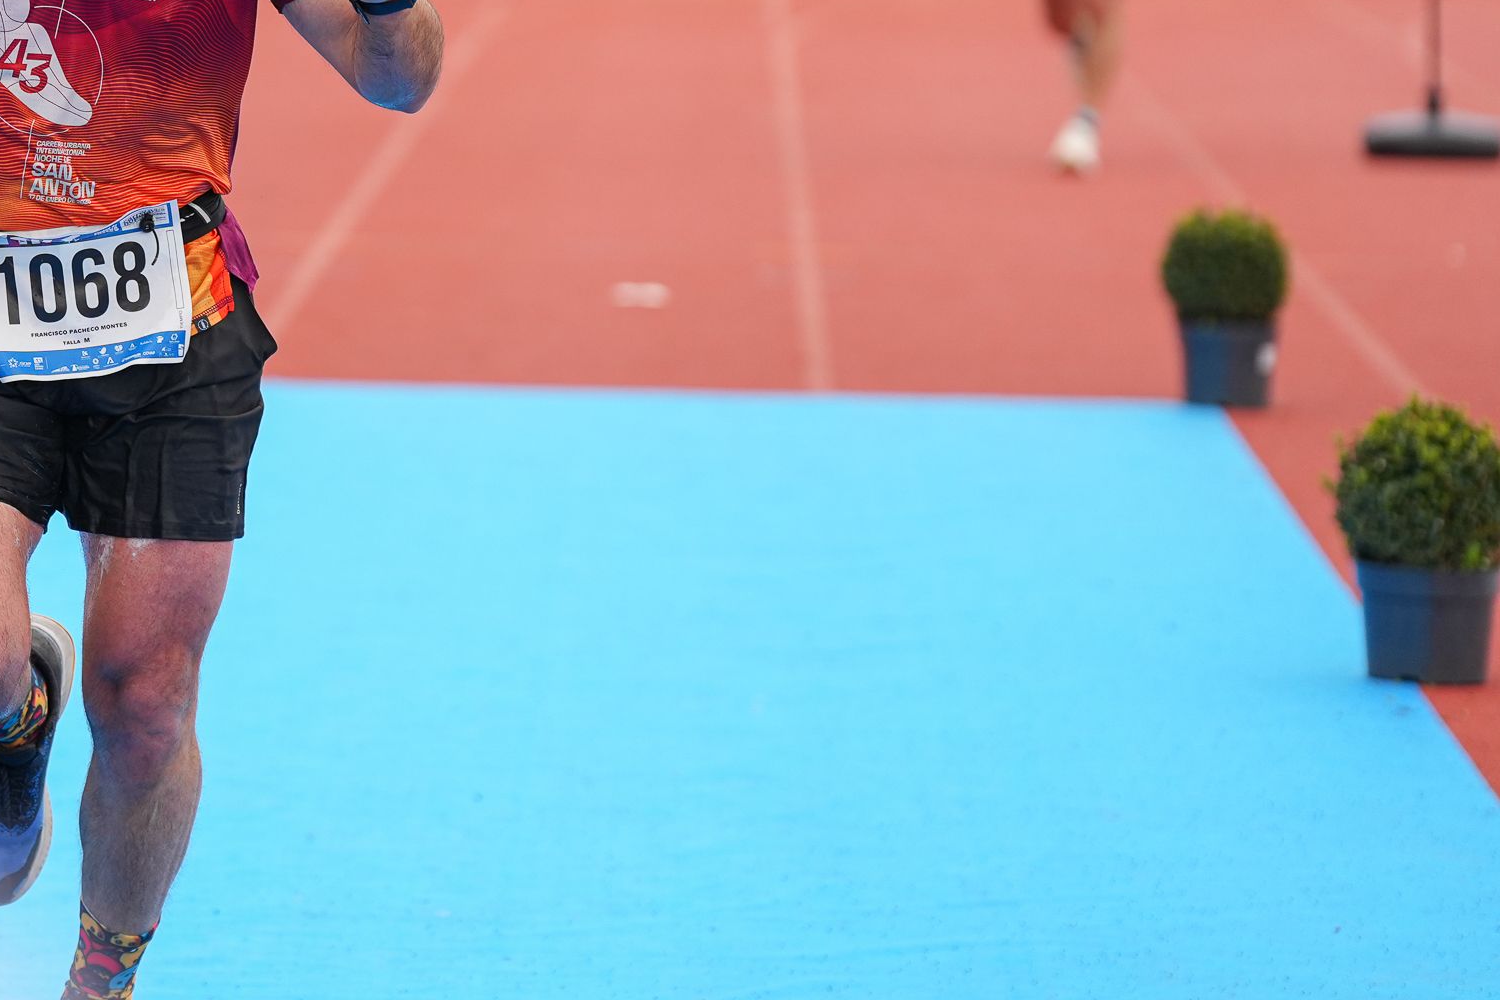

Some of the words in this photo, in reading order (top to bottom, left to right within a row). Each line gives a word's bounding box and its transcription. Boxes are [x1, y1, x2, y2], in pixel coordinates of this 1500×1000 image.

[33, 154, 63, 163] NOCHE
[63, 156, 72, 164] DE
[31, 162, 73, 181] SAN
[29, 176, 96, 199] ANTÓN
[36, 194, 45, 202] DE
[45, 195, 67, 203] ENERO
[31, 329, 68, 338] FRANCISCO
[69, 325, 99, 334] PACHECO
[100, 321, 128, 330] MONTES
